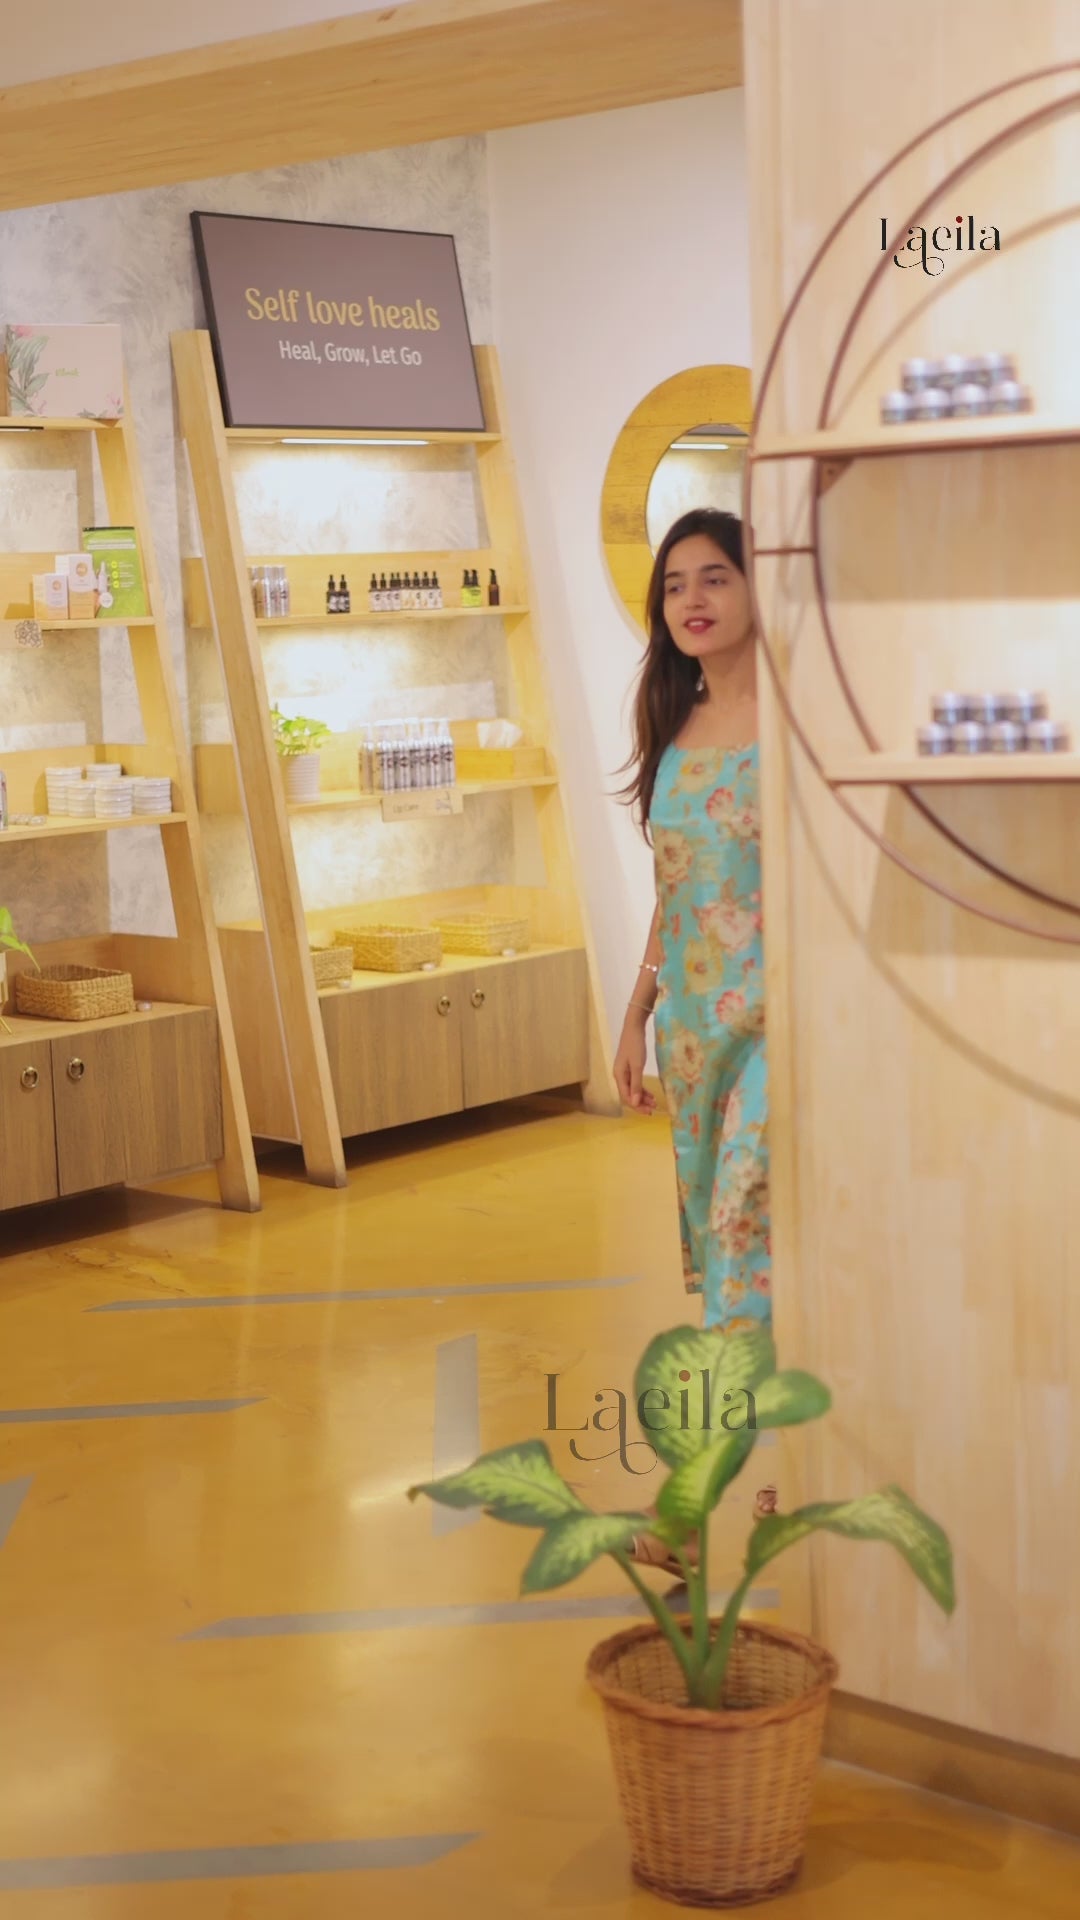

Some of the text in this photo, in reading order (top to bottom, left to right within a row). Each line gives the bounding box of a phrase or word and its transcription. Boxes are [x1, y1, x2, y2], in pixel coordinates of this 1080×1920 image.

[245, 287, 440, 331] Self love heals
[279, 340, 422, 367] Heal, Grow, Let Go
